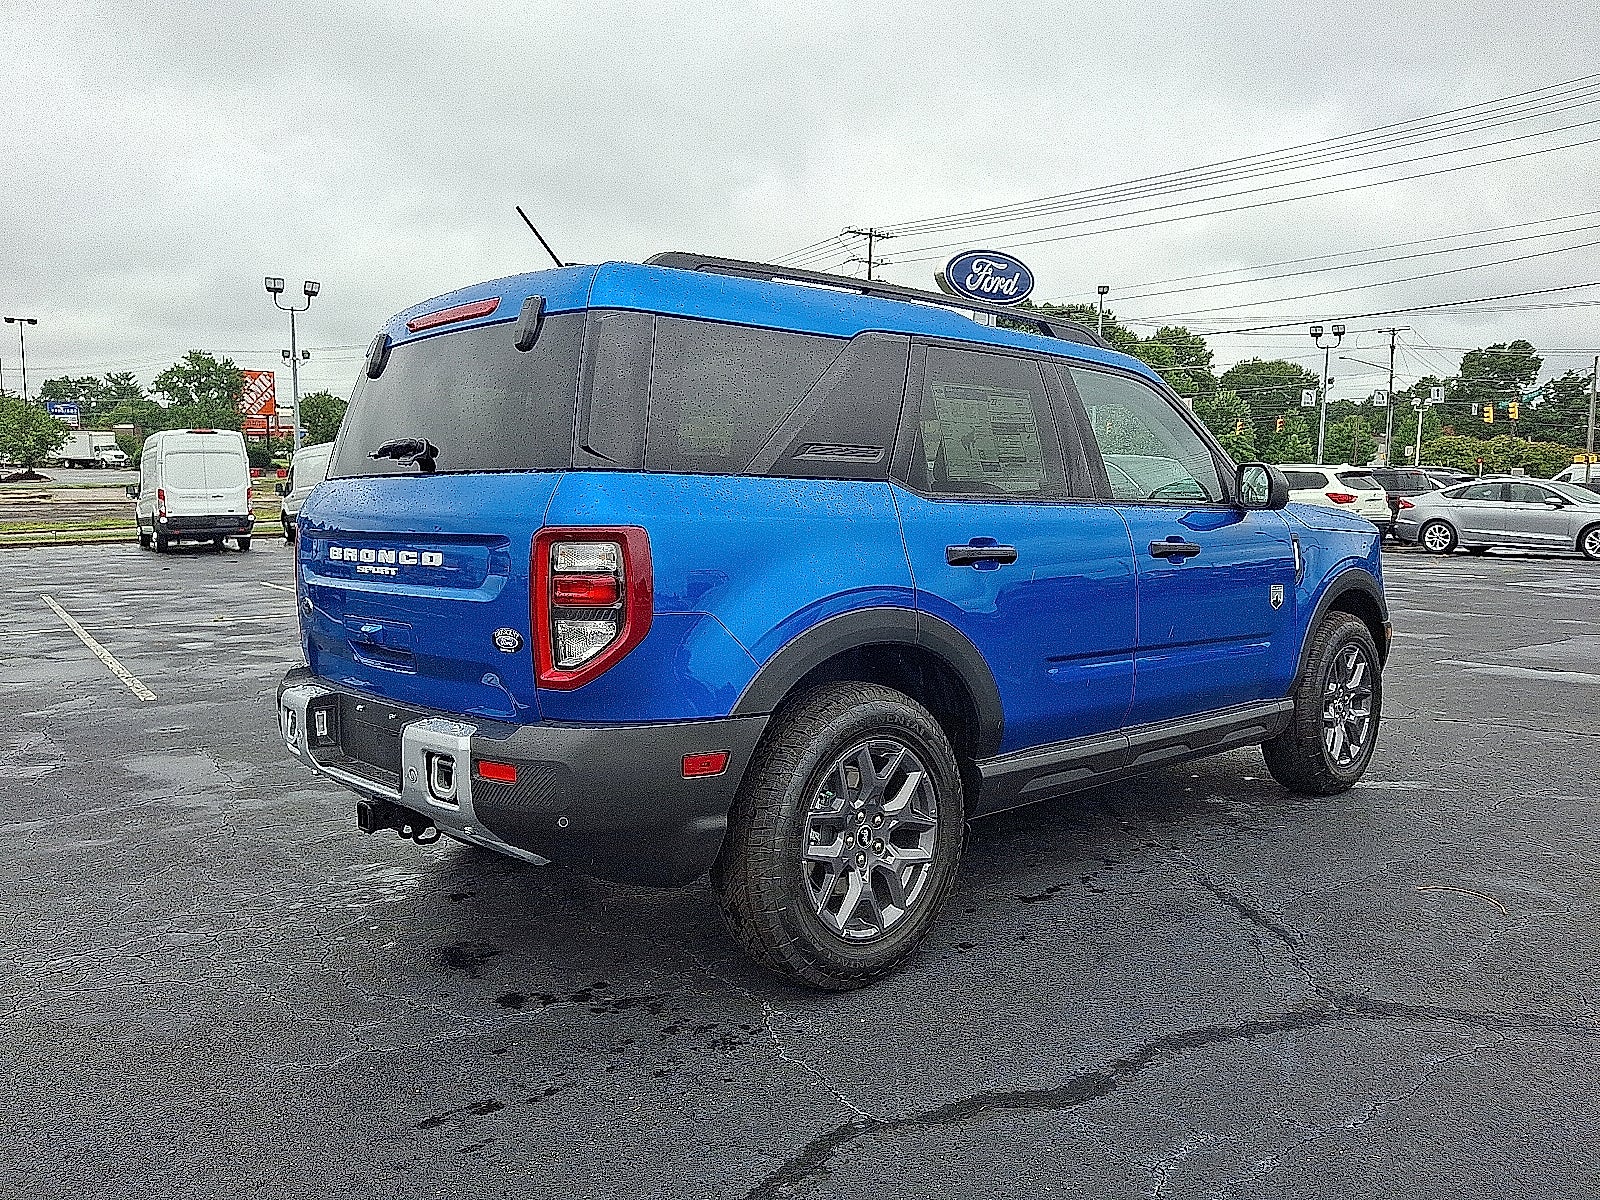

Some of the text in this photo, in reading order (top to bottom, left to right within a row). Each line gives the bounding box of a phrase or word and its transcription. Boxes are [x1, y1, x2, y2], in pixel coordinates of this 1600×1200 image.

[965, 258, 1020, 295] Ford
[249, 387, 274, 414] DEPOT
[329, 546, 443, 566] BRONCO
[356, 565, 399, 576] SPORT
